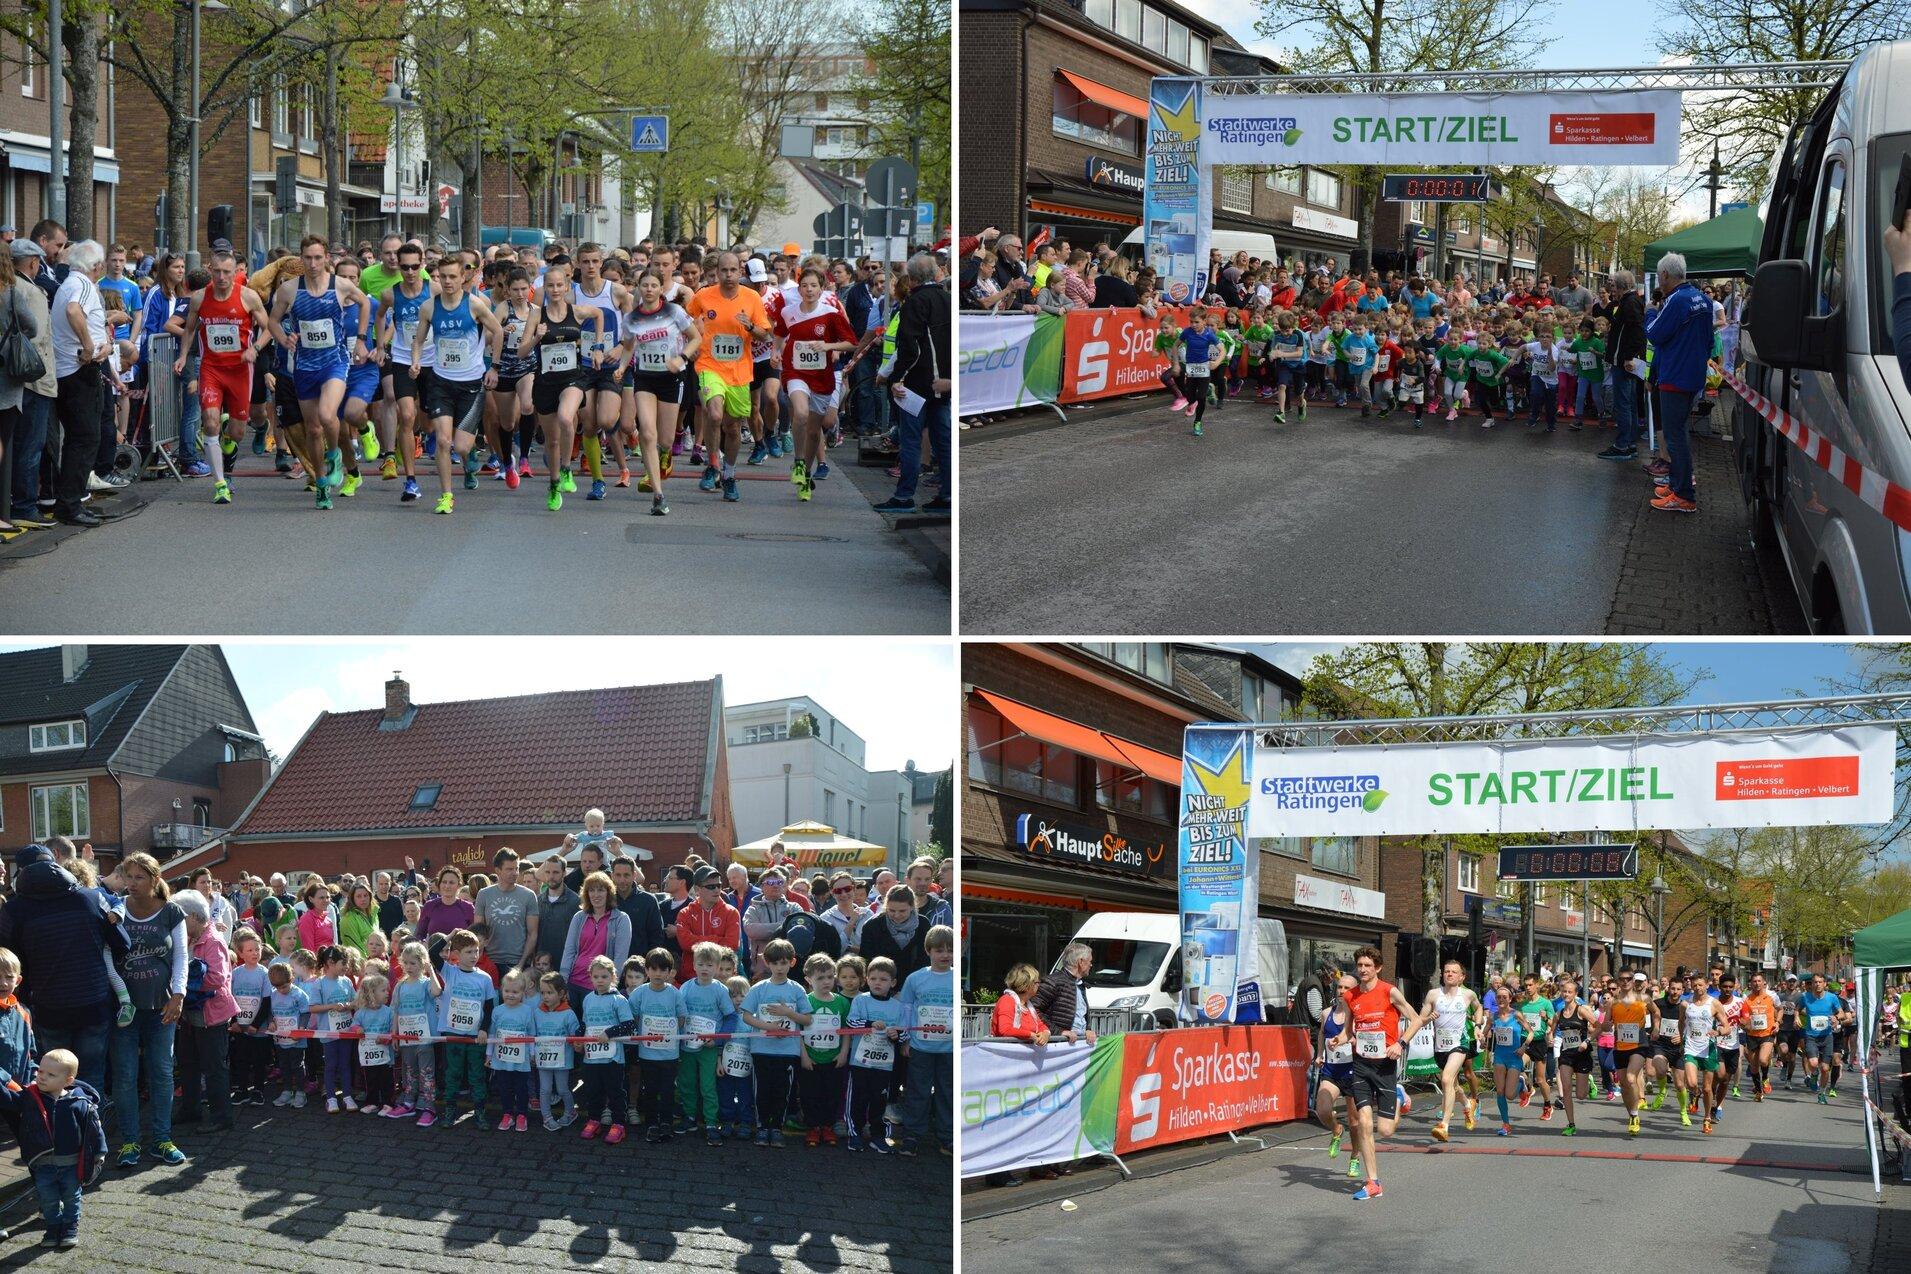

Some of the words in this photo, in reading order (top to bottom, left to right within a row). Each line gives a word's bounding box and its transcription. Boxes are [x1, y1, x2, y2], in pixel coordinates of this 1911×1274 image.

[1210, 117, 1295, 132] Stadtwerke
[1332, 116, 1519, 143] START/ZIEL
[1566, 126, 1601, 135] Sparkasse
[1152, 130, 1182, 143] NICHT
[1220, 130, 1284, 147] Ratingen
[1590, 135, 1620, 144] Ratingen
[1154, 154, 1174, 168] BIS
[1154, 165, 1189, 183] ZIEL!
[213, 336, 234, 346] 899
[306, 331, 328, 342] 859
[635, 328, 669, 342] team
[714, 344, 741, 355] 1181
[445, 353, 461, 363] 395
[550, 356, 568, 366] 490
[641, 353, 666, 364] 1121
[799, 352, 820, 363] 903
[1115, 366, 1150, 387] Hilden
[1264, 776, 1377, 794] Stadtwerke
[1428, 767, 1674, 806] START/ZIEL
[1738, 777, 1785, 787] Sparkasse
[1737, 788, 1765, 796] Hilden
[1771, 786, 1811, 797] Ratingen
[1817, 785, 1850, 794] Velbert
[1187, 794, 1225, 812] NICHT
[1277, 793, 1363, 813] Ratingen
[1188, 811, 1214, 824] MEHR
[1214, 807, 1247, 823] WEIT
[1189, 826, 1214, 843] BIS
[1215, 825, 1237, 838] ZUM
[1188, 839, 1232, 863] ZIEL!
[1193, 866, 1229, 874] EURONICS
[451, 1013, 474, 1026] 2058
[1564, 1036, 1579, 1044] 1160
[498, 1045, 520, 1056] 2079
[586, 1043, 610, 1052] 2078
[1364, 1045, 1379, 1053] 520
[364, 1050, 385, 1060] 2057
[539, 1052, 559, 1061] 2077
[863, 1049, 889, 1061] 2056
[727, 1059, 751, 1072] 2075
[1172, 1043, 1262, 1100] Sparkasse
[1168, 1107, 1203, 1131] Hilden
